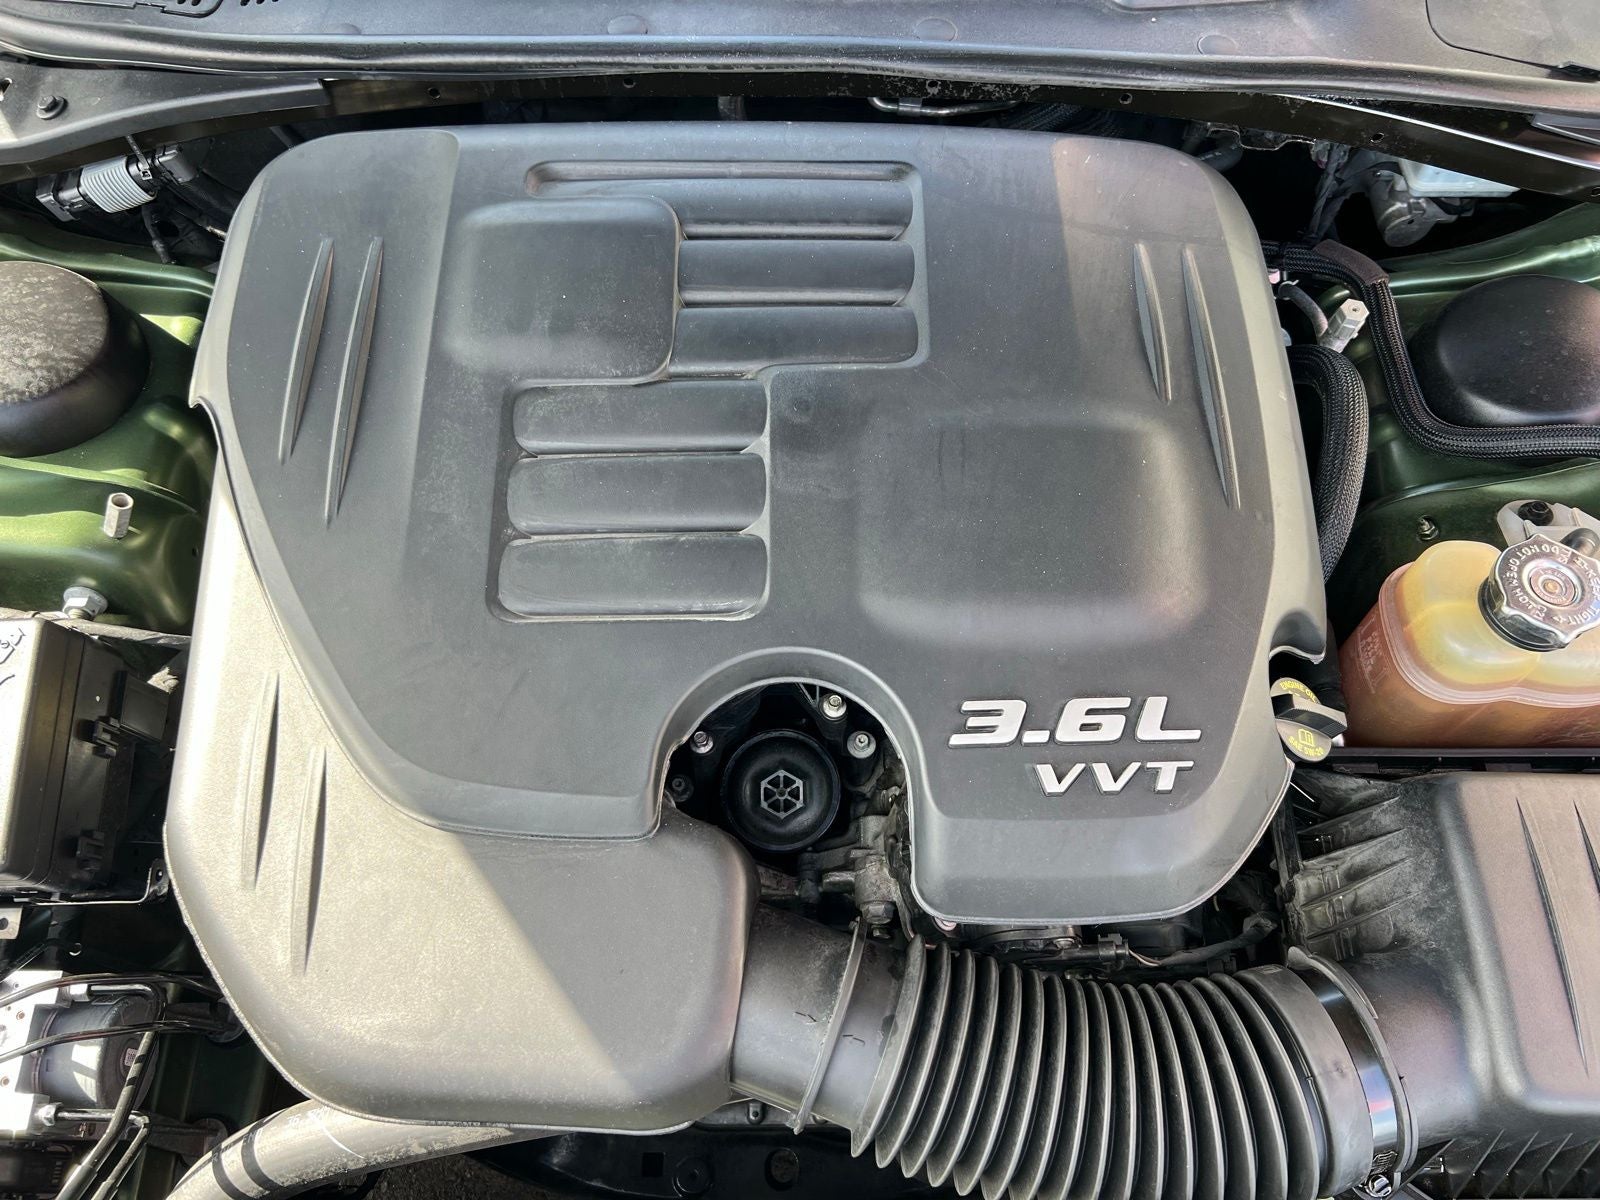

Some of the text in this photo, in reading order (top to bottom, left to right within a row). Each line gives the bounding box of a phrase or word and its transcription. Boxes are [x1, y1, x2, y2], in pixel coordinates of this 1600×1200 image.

[1516, 544, 1540, 560] NOT
[1541, 543, 1560, 555] DO
[1506, 558, 1520, 587] OPEN
[1511, 588, 1537, 609] HOT
[1305, 689, 1316, 703] OIL
[949, 696, 1201, 747] 3.6L
[1034, 760, 1194, 796] VVT
